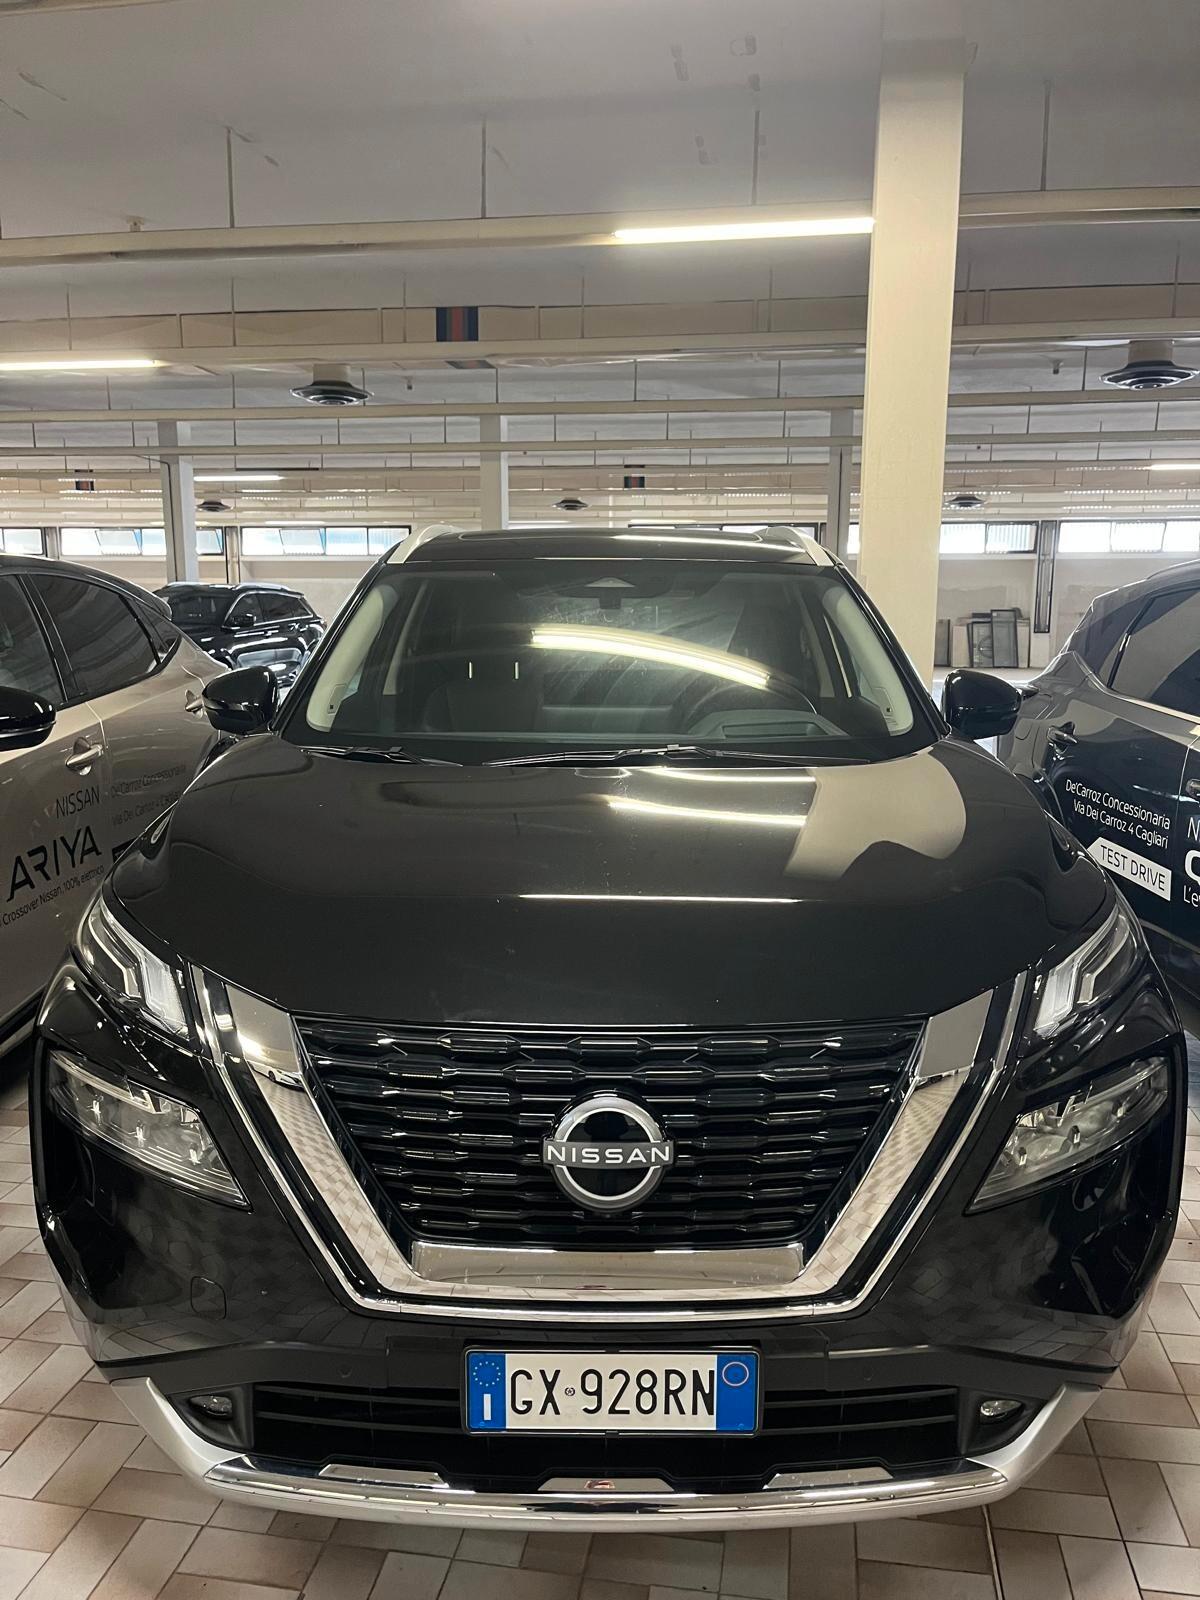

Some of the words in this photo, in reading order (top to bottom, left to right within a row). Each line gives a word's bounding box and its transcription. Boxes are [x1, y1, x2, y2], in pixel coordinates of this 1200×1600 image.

[56, 785, 100, 819] NISSAN
[1102, 793, 1171, 830] Concessionaria
[1073, 799, 1085, 815] Via
[1086, 805, 1099, 821] Dei
[1100, 811, 1127, 832] Carroz
[1128, 822, 1134, 835] 4
[1135, 825, 1169, 849] Cagliari
[6, 825, 102, 902] ARIYA
[1100, 844, 1128, 871] TEST
[1130, 859, 1166, 892] DRIVE
[2, 896, 39, 926] Crossover
[547, 1145, 670, 1164] NISSAN
[510, 1368, 561, 1416] GX
[580, 1368, 715, 1416] 928RN
